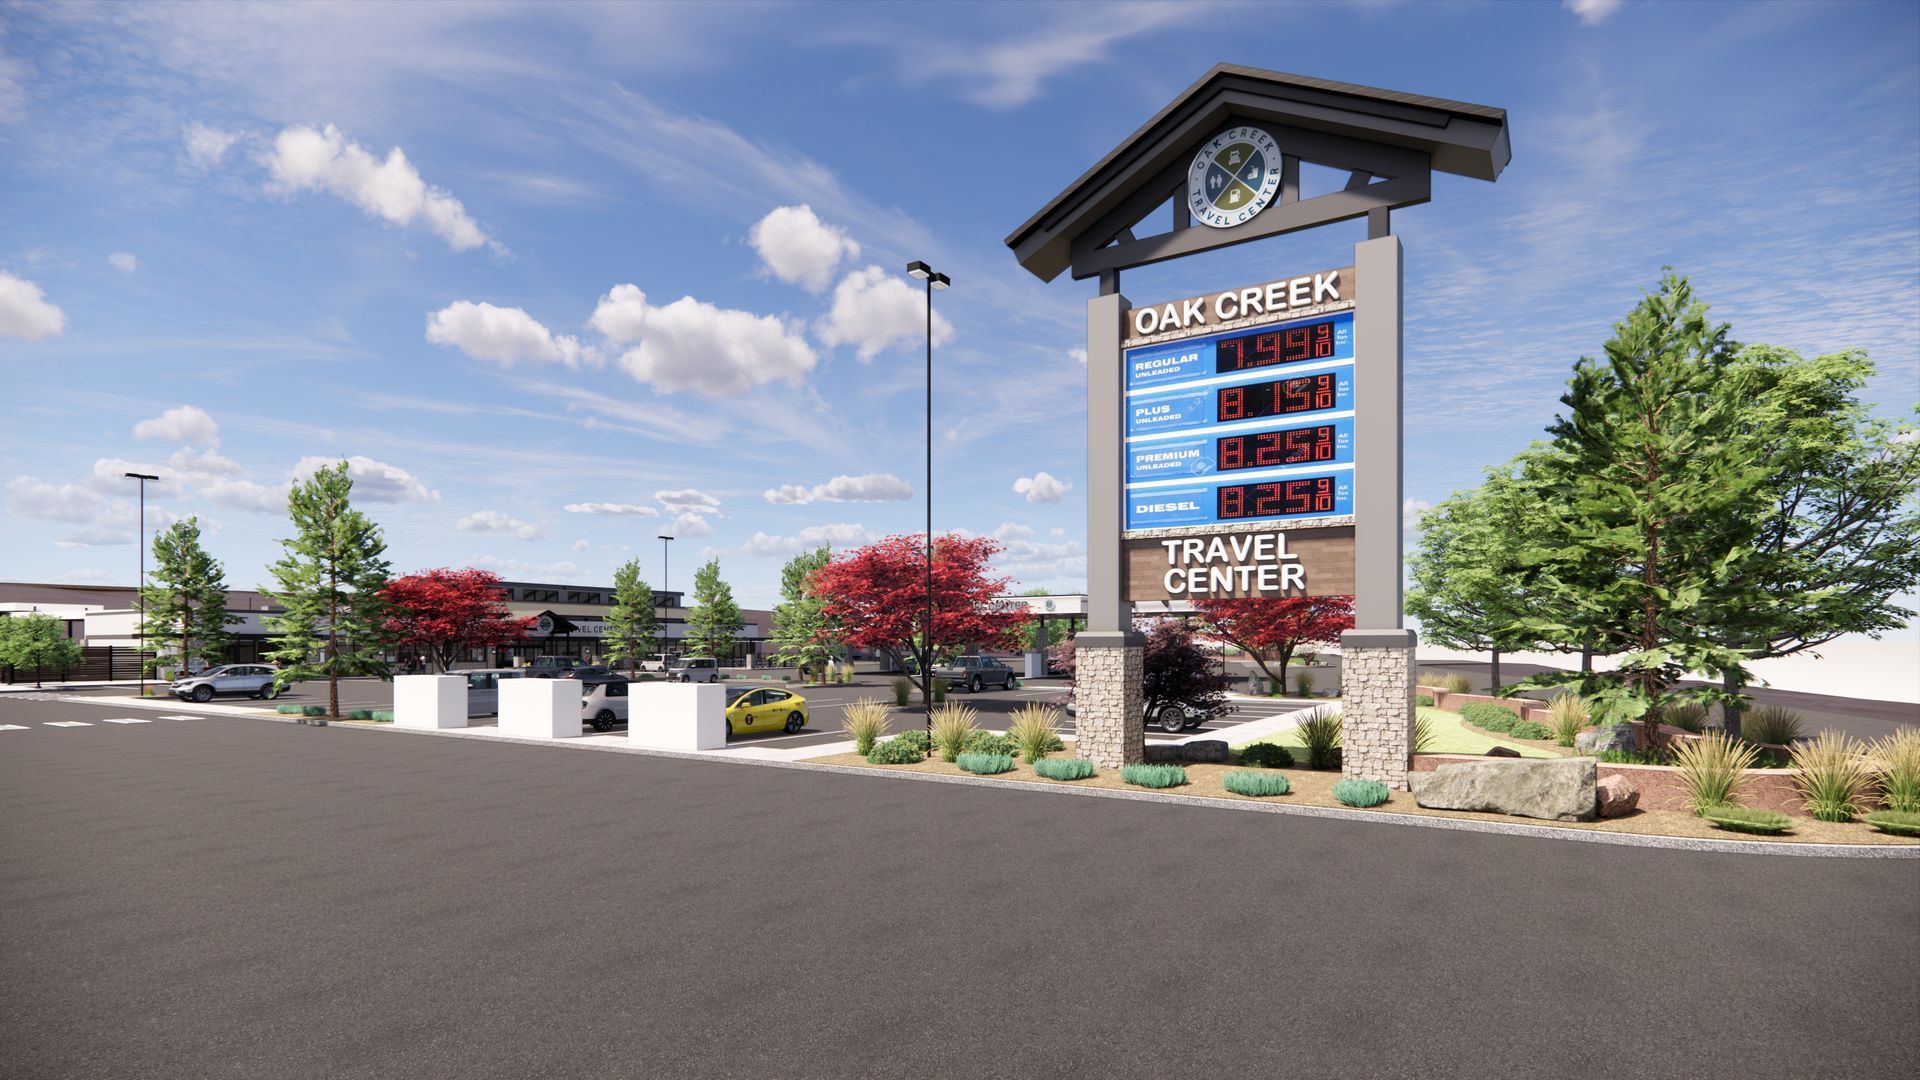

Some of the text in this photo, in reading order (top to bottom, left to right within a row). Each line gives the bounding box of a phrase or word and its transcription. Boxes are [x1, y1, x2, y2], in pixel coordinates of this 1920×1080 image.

[1197, 129, 1274, 169] OAK CREEK
[1192, 168, 1279, 225] TRAVEL CENTER
[1135, 270, 1340, 334] OAK CREEK
[1135, 354, 1198, 371] REGULAR
[1135, 366, 1180, 378] UNLEADED
[1136, 405, 1170, 416] PLUS
[1136, 413, 1181, 425] UNLEADED
[1136, 450, 1199, 463] PREMIUM
[1136, 462, 1182, 470] UNLEADED
[1136, 502, 1199, 513] DIESEL
[1162, 532, 1298, 565] TRAVEL
[1164, 564, 1305, 593] CENTER
